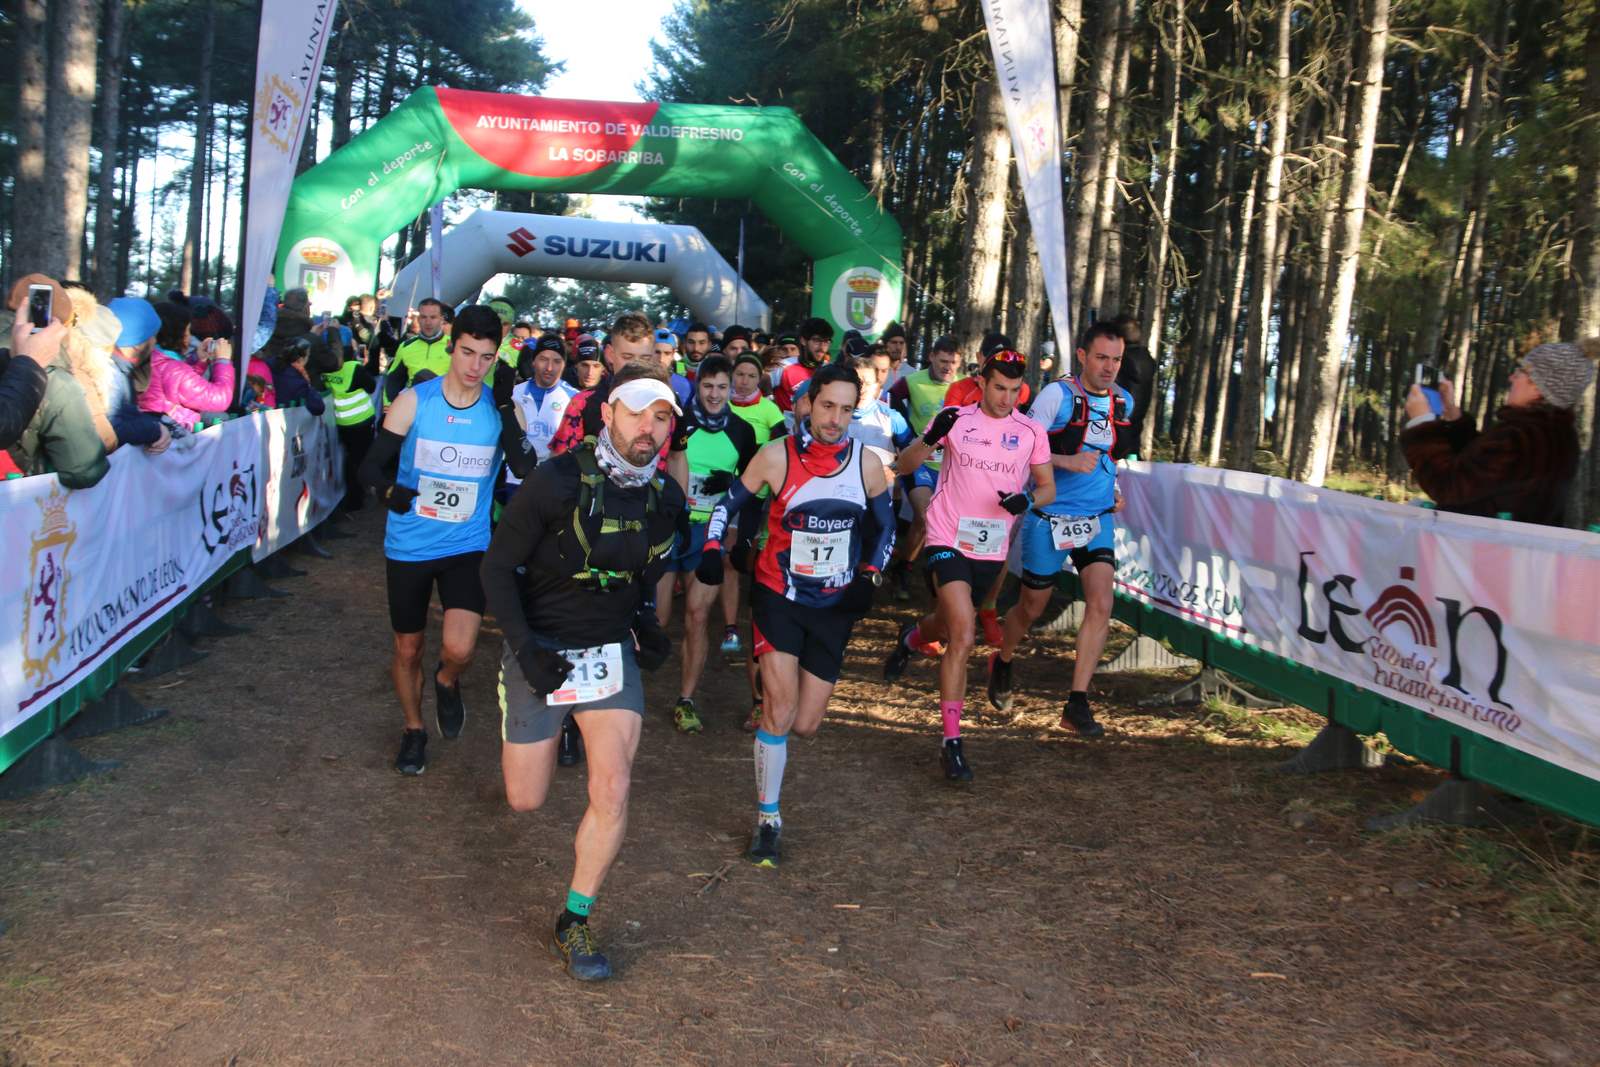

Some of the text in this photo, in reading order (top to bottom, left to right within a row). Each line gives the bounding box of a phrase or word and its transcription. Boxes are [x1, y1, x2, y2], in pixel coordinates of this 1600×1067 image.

[300, 0, 327, 88] AYUNTA
[476, 115, 744, 141] AYUNTAMIENTO DE VALDEFRESNO
[548, 146, 664, 165] LA SOBARRIBA
[341, 141, 432, 209] Con el deporte
[783, 162, 863, 236] Con el deporte
[543, 235, 666, 263] SUZUKI
[439, 446, 491, 468] Ojanco
[433, 491, 460, 508] 20
[977, 530, 988, 543] 3
[1062, 522, 1092, 537] 463
[810, 546, 834, 562] 17
